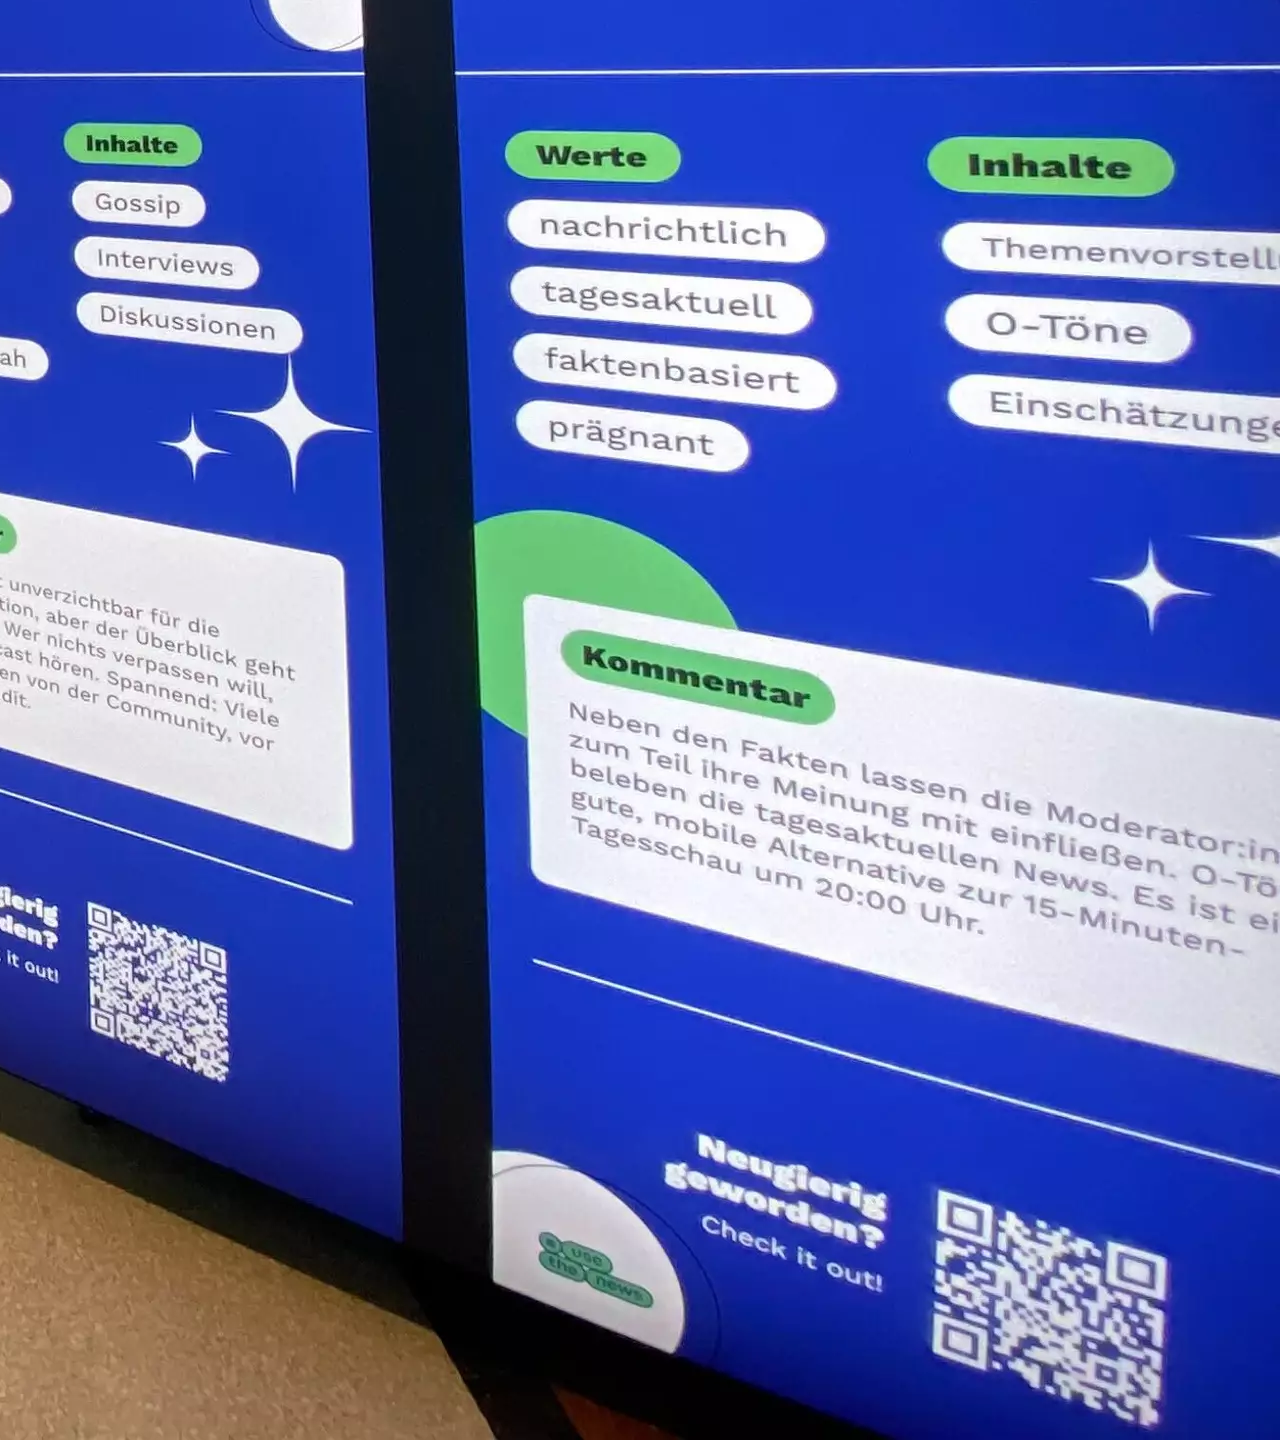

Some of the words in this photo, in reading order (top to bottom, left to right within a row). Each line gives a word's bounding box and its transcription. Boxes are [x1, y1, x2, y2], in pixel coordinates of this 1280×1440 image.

[85, 134, 179, 155] Inhalte
[536, 145, 648, 168] Werte
[968, 153, 1132, 182] Inhalte
[94, 191, 181, 219] Gossip
[539, 213, 788, 249] nachrichtlich
[96, 248, 234, 278] Interviews
[981, 236, 1280, 270] Themenvorstell
[542, 279, 778, 322] tagesaktuell
[99, 304, 277, 341] Diskussionen
[986, 311, 1150, 348] O-Töne
[544, 346, 802, 395] faktenbasiert
[547, 416, 716, 458] prägnant
[582, 645, 812, 710] Kommentar
[6, 949, 20, 969] it
[24, 960, 59, 984] out!
[698, 1133, 888, 1223] Neugierig
[664, 1161, 885, 1250] geworden?
[701, 1214, 787, 1261] Check
[797, 1245, 818, 1271] it
[826, 1261, 883, 1293] out!
